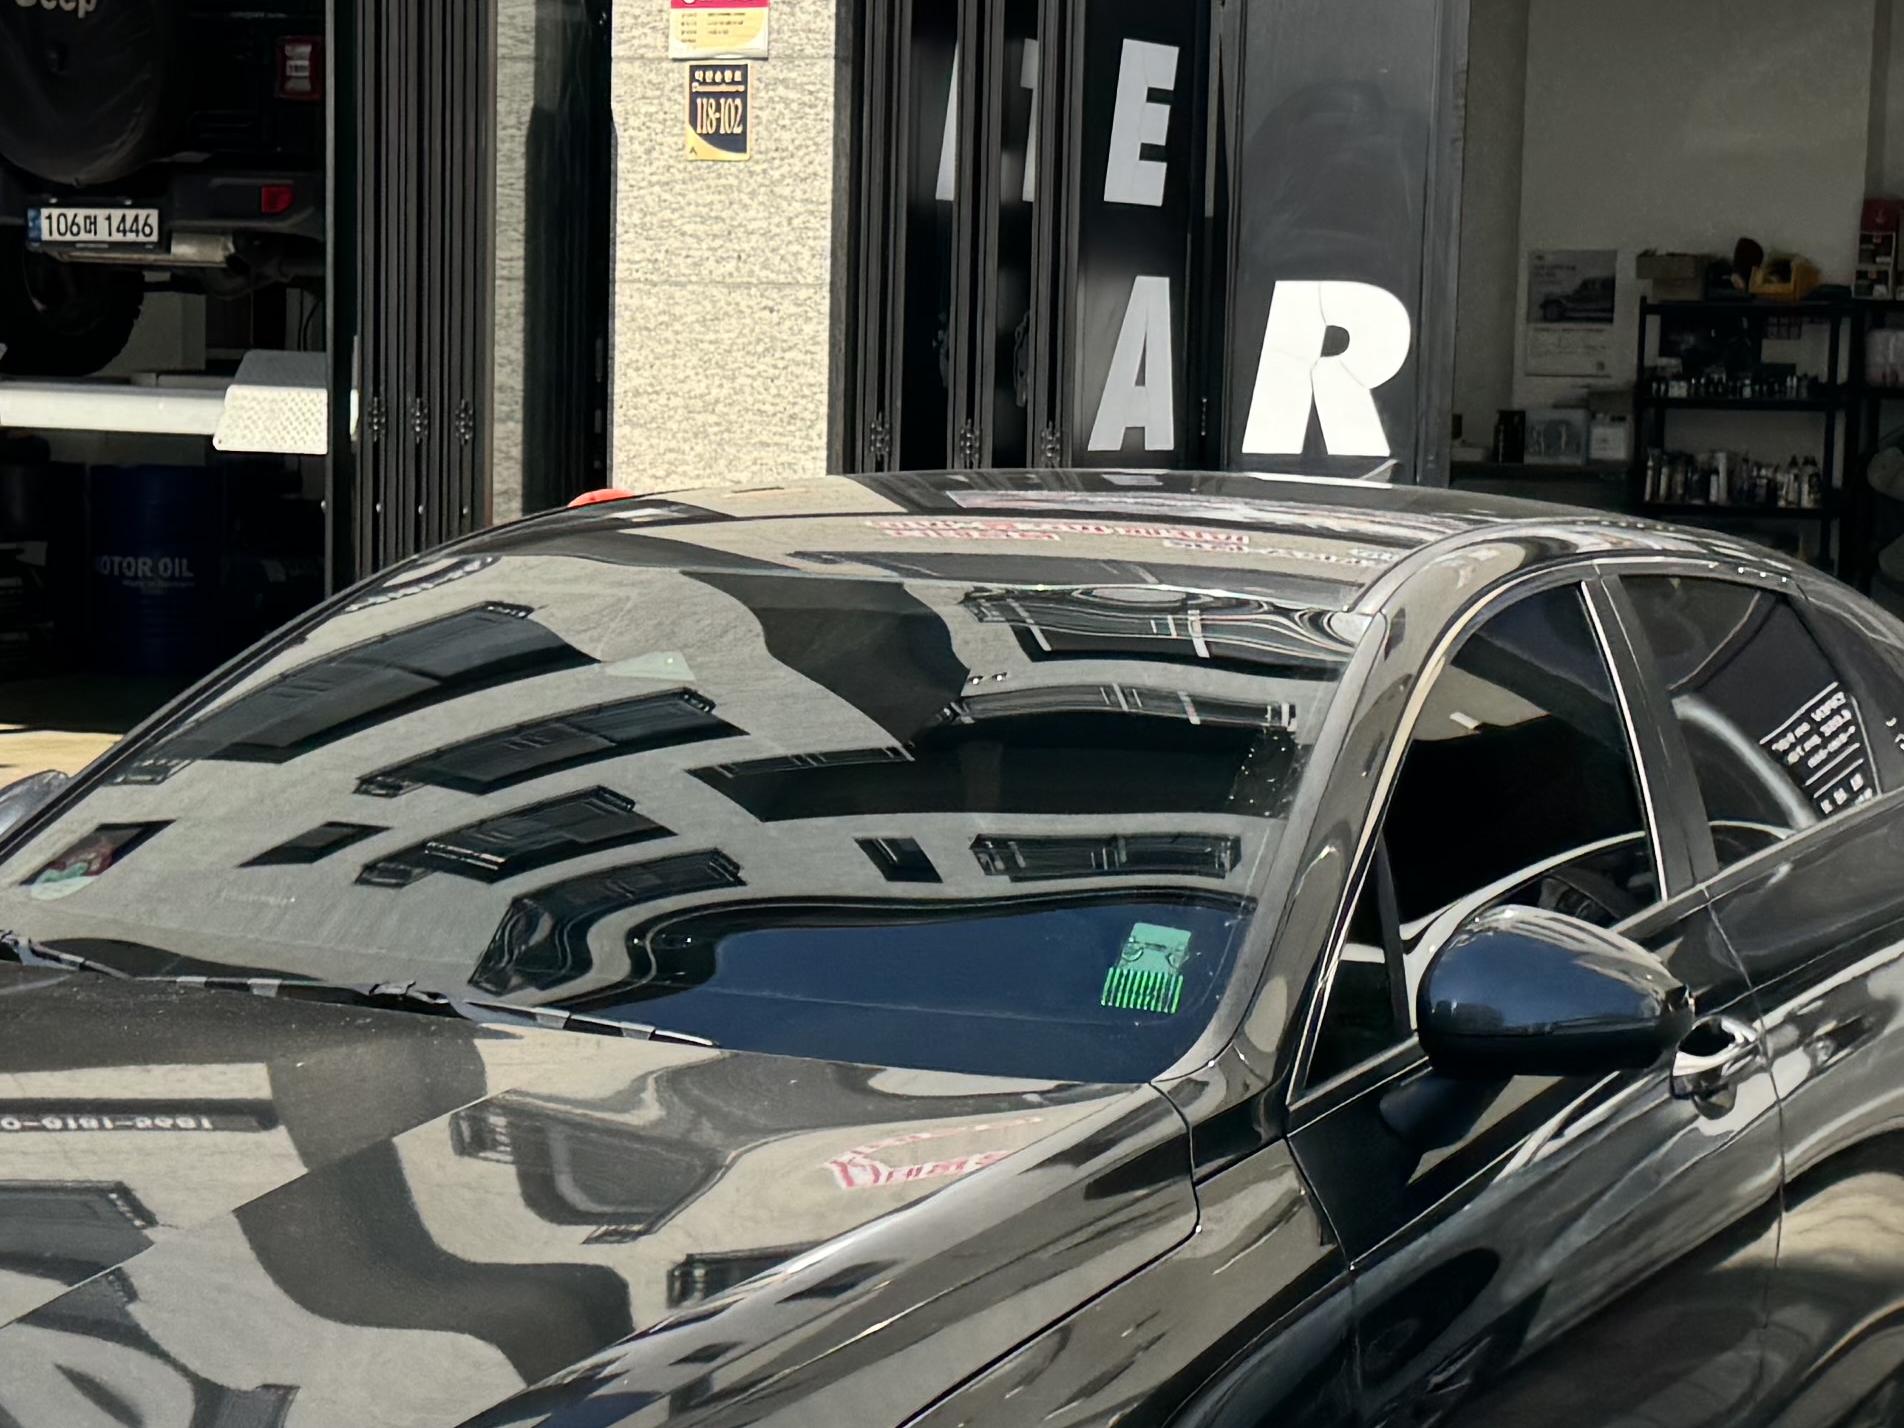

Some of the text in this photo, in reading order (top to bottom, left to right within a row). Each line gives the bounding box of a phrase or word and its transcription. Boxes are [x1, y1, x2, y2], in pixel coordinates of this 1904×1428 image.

[696, 97, 744, 135] 118-102
[103, 212, 155, 238] 1446
[158, 557, 195, 578] OIL
